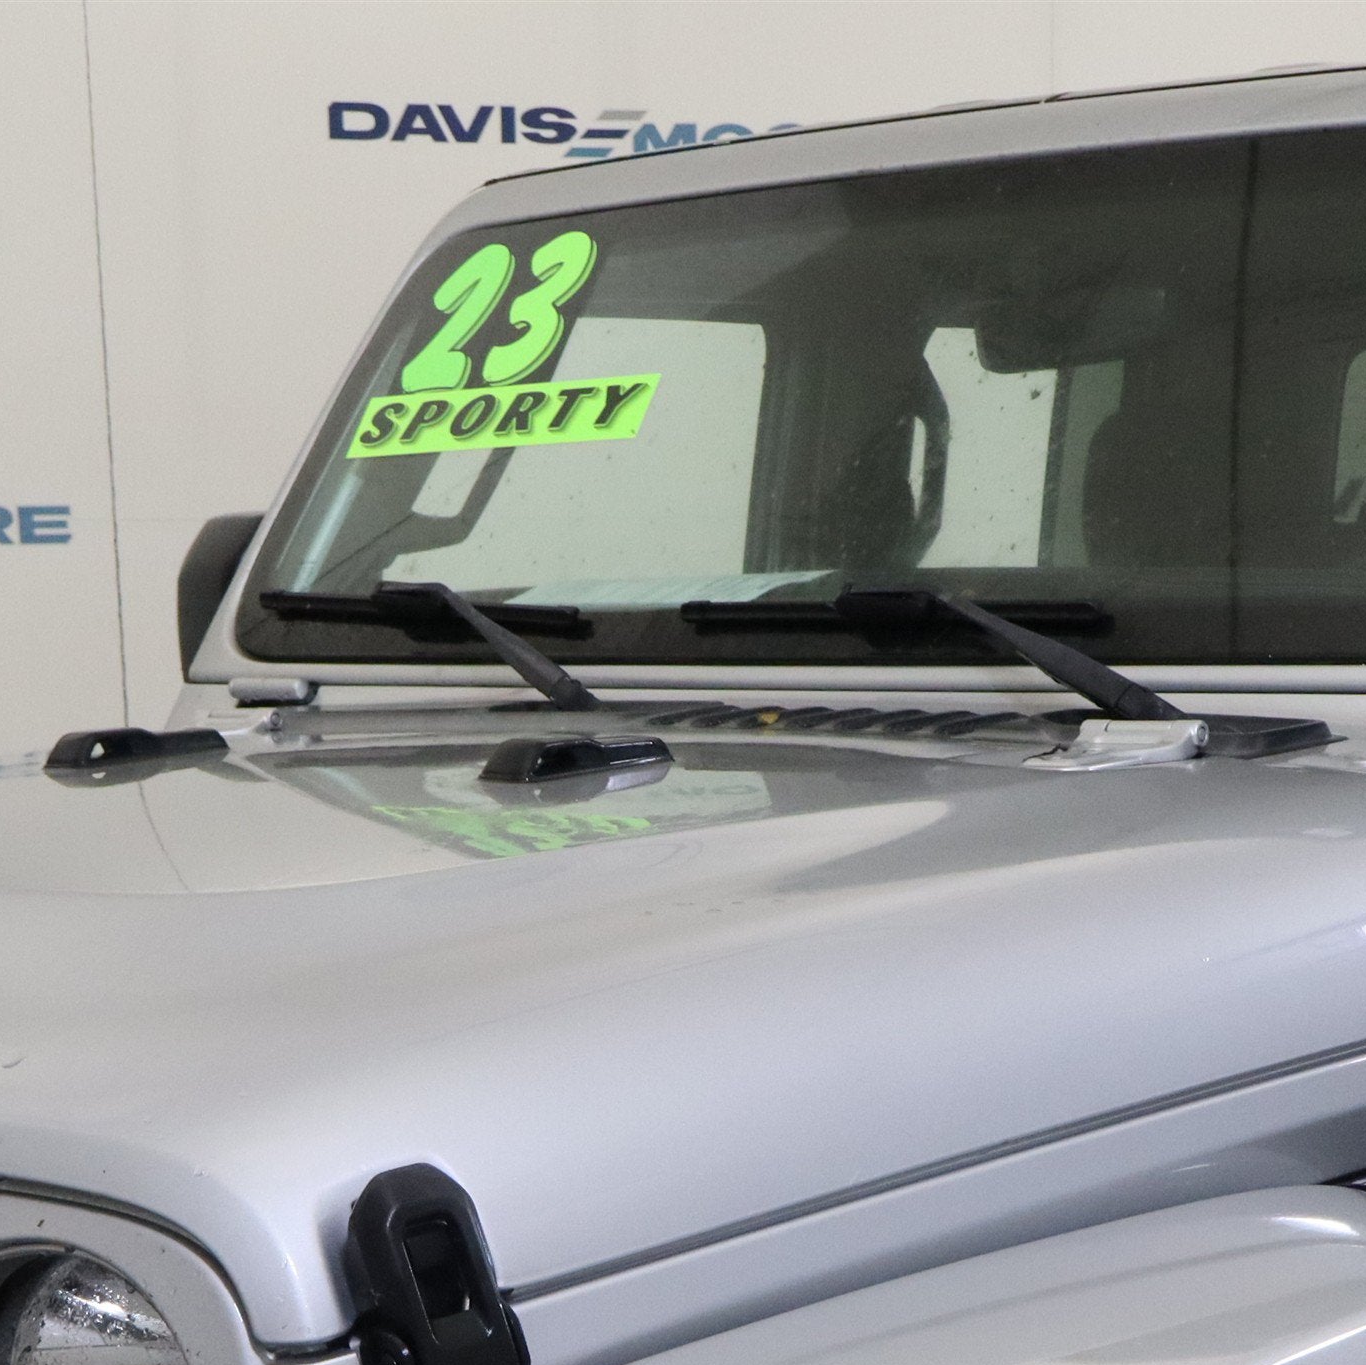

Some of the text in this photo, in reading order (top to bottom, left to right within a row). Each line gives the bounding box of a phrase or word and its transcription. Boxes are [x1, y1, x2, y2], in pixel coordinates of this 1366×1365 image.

[328, 101, 557, 145] DAVIS
[401, 231, 598, 394] 23
[360, 382, 651, 448] SPORTY
